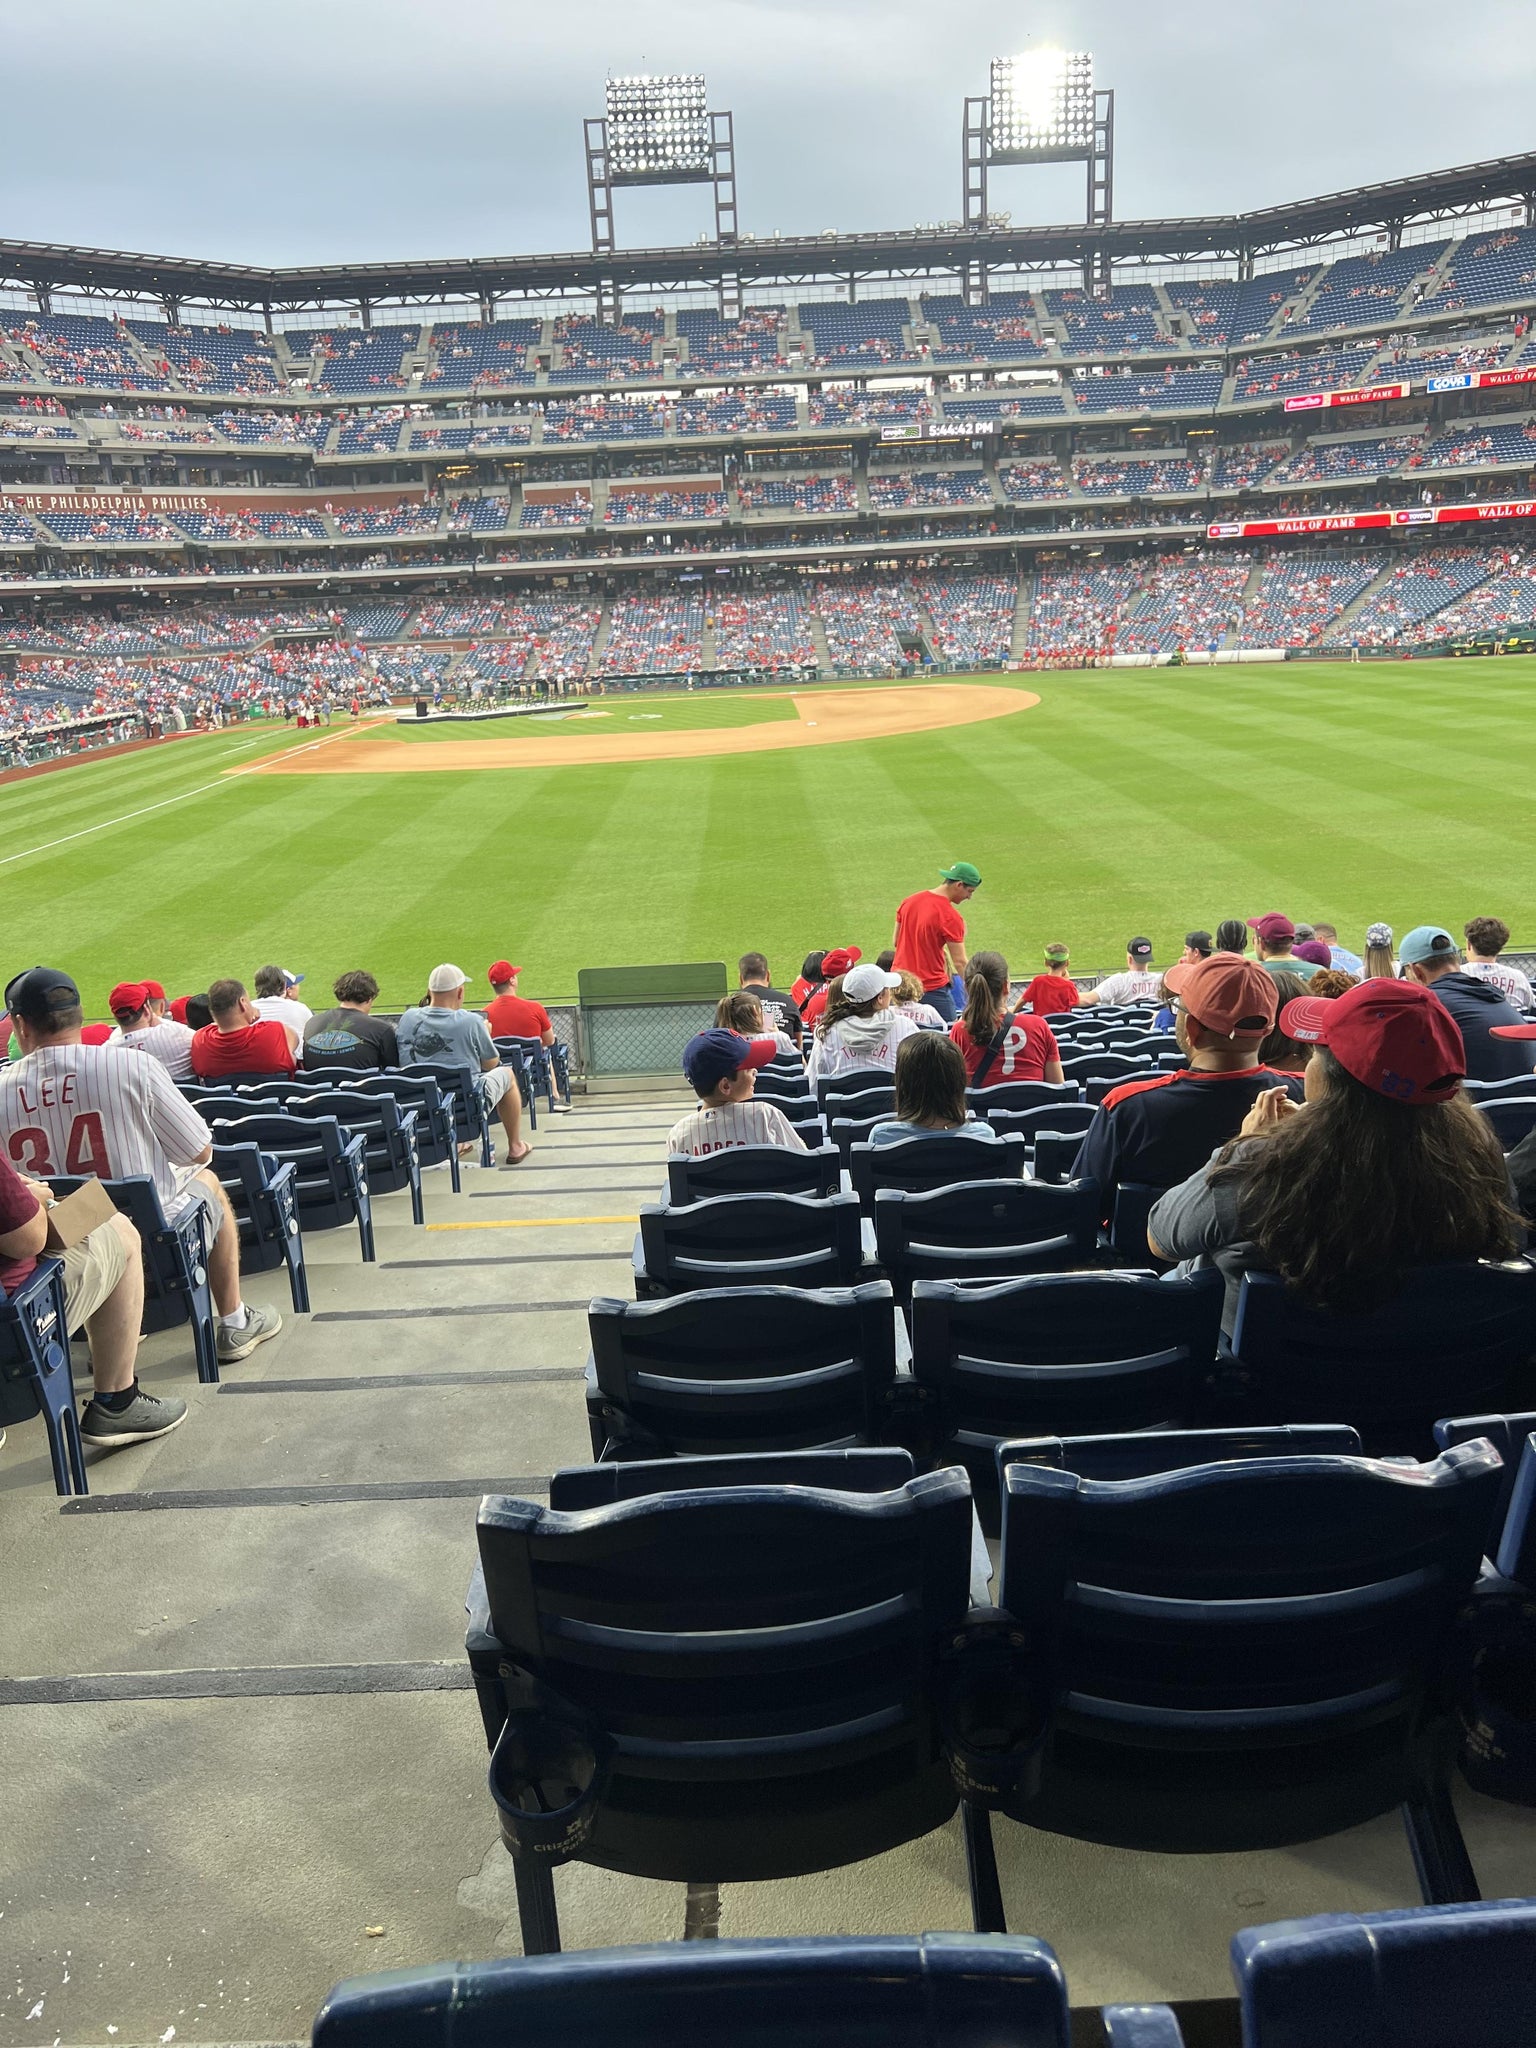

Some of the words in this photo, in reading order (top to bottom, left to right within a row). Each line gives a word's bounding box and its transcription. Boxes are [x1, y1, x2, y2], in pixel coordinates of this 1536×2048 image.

[1433, 376, 1466, 389] GOYA
[1490, 374, 1512, 383] WALL
[1339, 395, 1359, 403] WALL
[1373, 390, 1393, 399] FAME
[928, 423, 973, 436] 5:44:42
[975, 421, 993, 434] PM
[17, 496, 43, 509] HE
[50, 496, 146, 509] PHILADELPHIA
[152, 496, 208, 510] PHILLIES
[1477, 506, 1513, 517] WALL
[1516, 504, 1533, 514] OF
[1277, 521, 1306, 532] WALL
[1308, 520, 1322, 530] OF
[1325, 518, 1356, 529] FAME
[18, 1072, 77, 1114] LEE
[8, 1111, 113, 1180] 34
